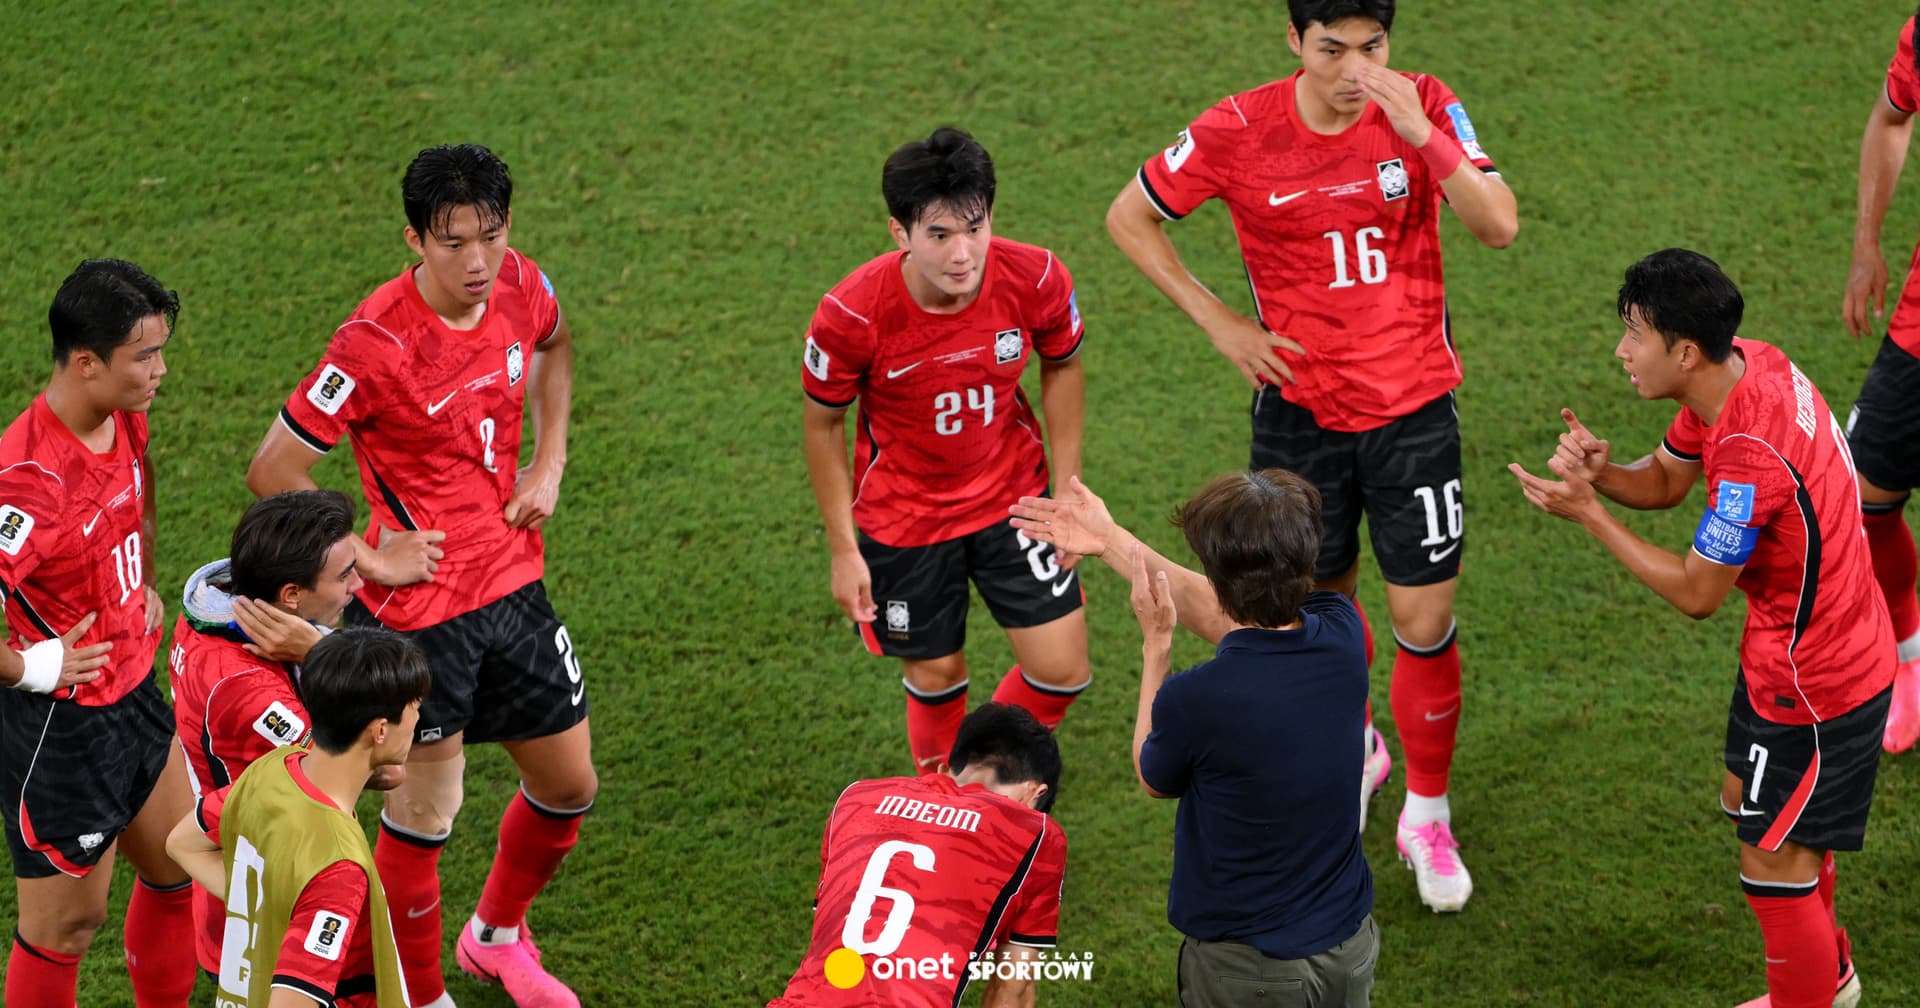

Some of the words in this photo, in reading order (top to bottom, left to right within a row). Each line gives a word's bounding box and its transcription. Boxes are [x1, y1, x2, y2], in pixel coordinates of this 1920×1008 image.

[1323, 227, 1387, 289] 16
[934, 384, 995, 436] 24
[479, 417, 498, 473] 2
[1413, 478, 1463, 547] 16
[1705, 522, 1742, 547] UNITES
[1710, 514, 1744, 538] FOOTBALL
[111, 531, 142, 607] 18
[1711, 540, 1742, 557] World
[554, 625, 582, 684] 2
[1748, 743, 1769, 804] 7
[874, 795, 982, 833] INBEOM
[841, 839, 937, 956] 6
